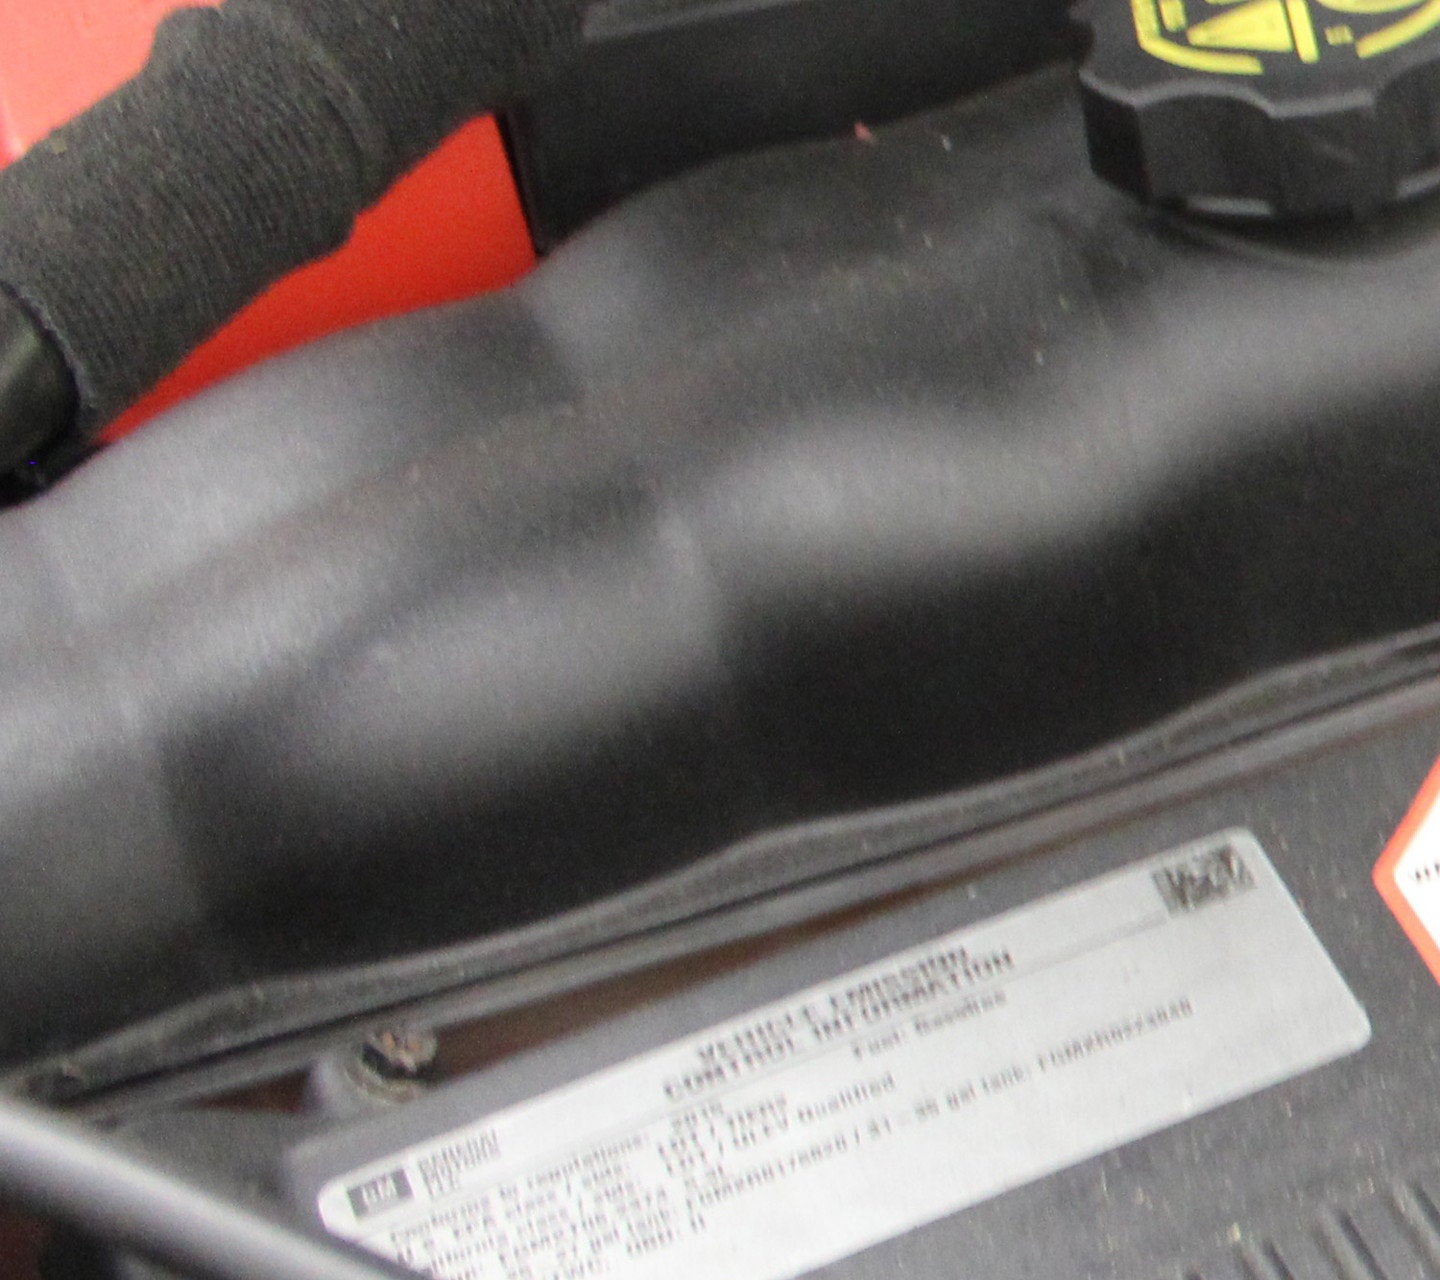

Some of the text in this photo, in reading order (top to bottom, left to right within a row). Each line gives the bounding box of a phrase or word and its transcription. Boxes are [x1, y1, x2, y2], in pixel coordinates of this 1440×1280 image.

[662, 950, 1014, 1099] CONTROL INFORMATION
[696, 947, 970, 1067] VEHICLE EMISSION
